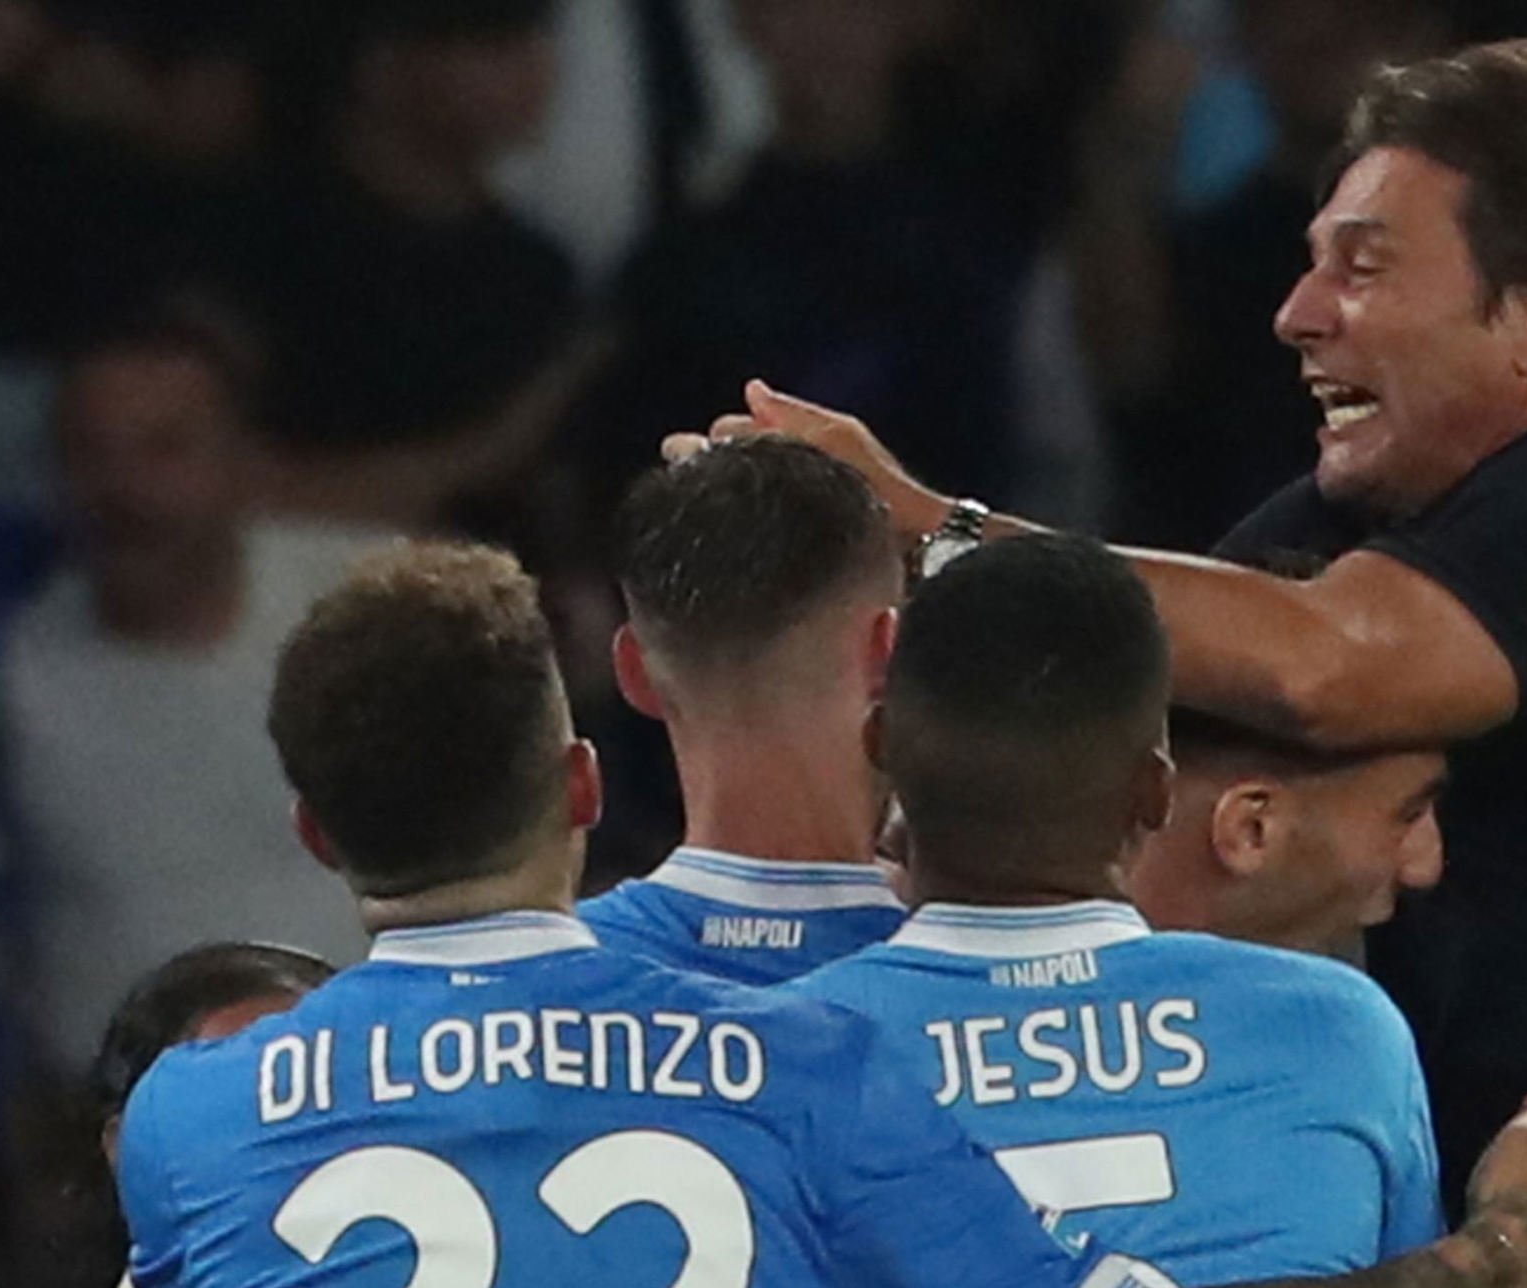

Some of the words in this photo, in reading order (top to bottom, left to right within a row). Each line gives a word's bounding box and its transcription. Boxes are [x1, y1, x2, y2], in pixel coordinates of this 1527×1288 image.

[258, 1028, 331, 1123] DI
[367, 1009, 765, 1104] LORENZO
[925, 999, 1207, 1106] JESUS
